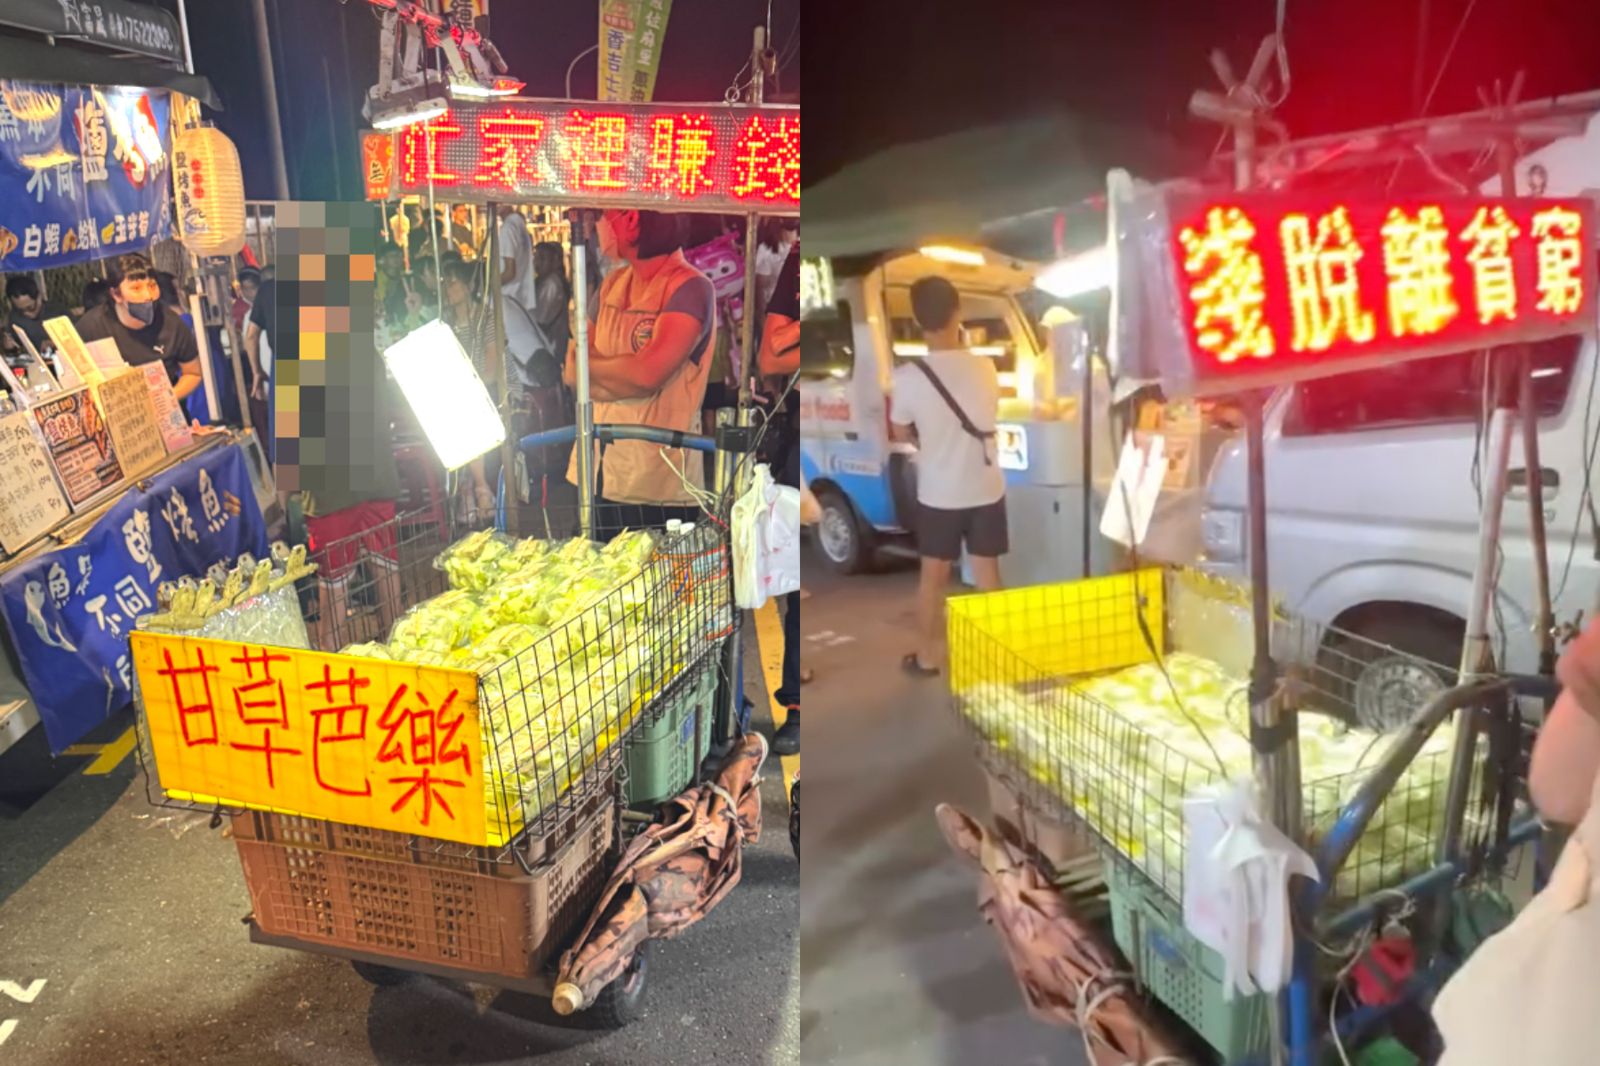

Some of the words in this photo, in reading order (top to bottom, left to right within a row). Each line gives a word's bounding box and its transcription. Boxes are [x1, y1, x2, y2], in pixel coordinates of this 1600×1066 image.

[22, 223, 61, 259] 白蝦
[157, 645, 472, 826] 甘草芭樂
